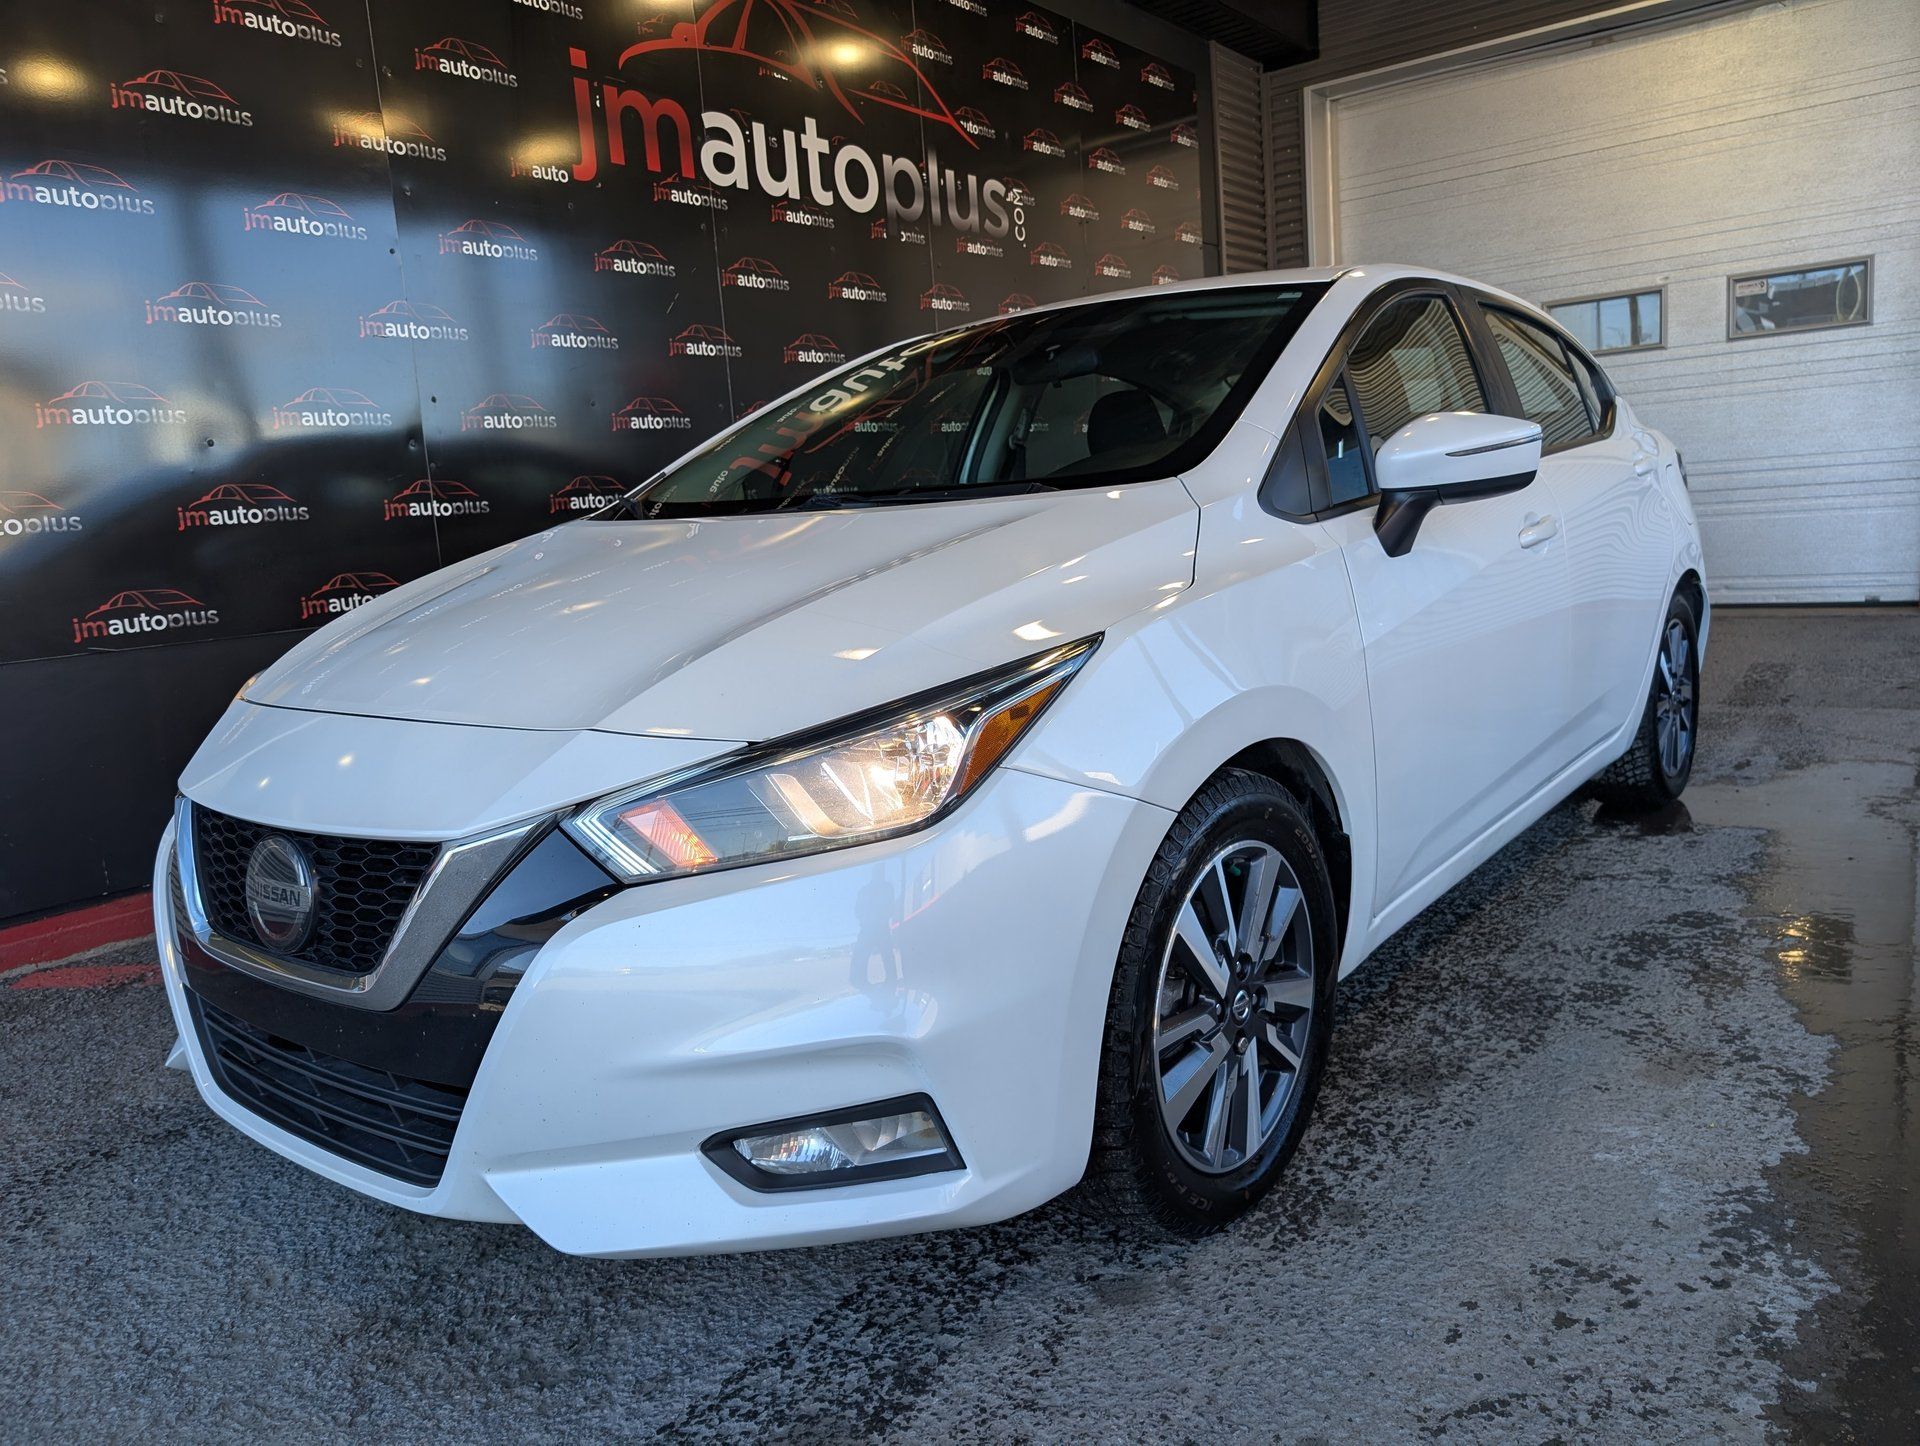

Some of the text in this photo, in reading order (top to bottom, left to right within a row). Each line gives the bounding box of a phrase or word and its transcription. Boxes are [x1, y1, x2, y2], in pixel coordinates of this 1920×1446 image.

[213, 0, 342, 48] jmautoplus
[900, 36, 953, 66] jmautoplus
[415, 48, 518, 88] jmautoplus
[111, 83, 253, 128] jmautoplus
[333, 124, 447, 162] jmautoplus
[568, 46, 1010, 242] jmautoplus
[0, 177, 155, 216] jmautoplus
[653, 182, 728, 211] jmautoplus
[244, 207, 368, 242] jmautoplus
[771, 200, 835, 230] jmautoplus
[438, 234, 538, 262] jmautoplus
[594, 252, 676, 279] jmautoplus
[721, 268, 790, 292] jmautoplus
[828, 283, 888, 303] jmautoplus
[145, 300, 283, 329] jmautoplus
[358, 315, 469, 342] jmautoplus
[531, 328, 619, 350] jmautoplus
[668, 338, 742, 358] jmautoplus
[783, 346, 846, 365] jmautoplus
[35, 402, 188, 430] jmautoplus
[271, 406, 393, 431] jmautoplus
[460, 411, 557, 433] jmautoplus
[611, 412, 692, 432] jmautoplus
[177, 503, 310, 533] jmautoplus
[384, 499, 490, 521] jmautoplus
[72, 608, 220, 645] jmautoplus
[251, 879, 301, 908] NISSAN
